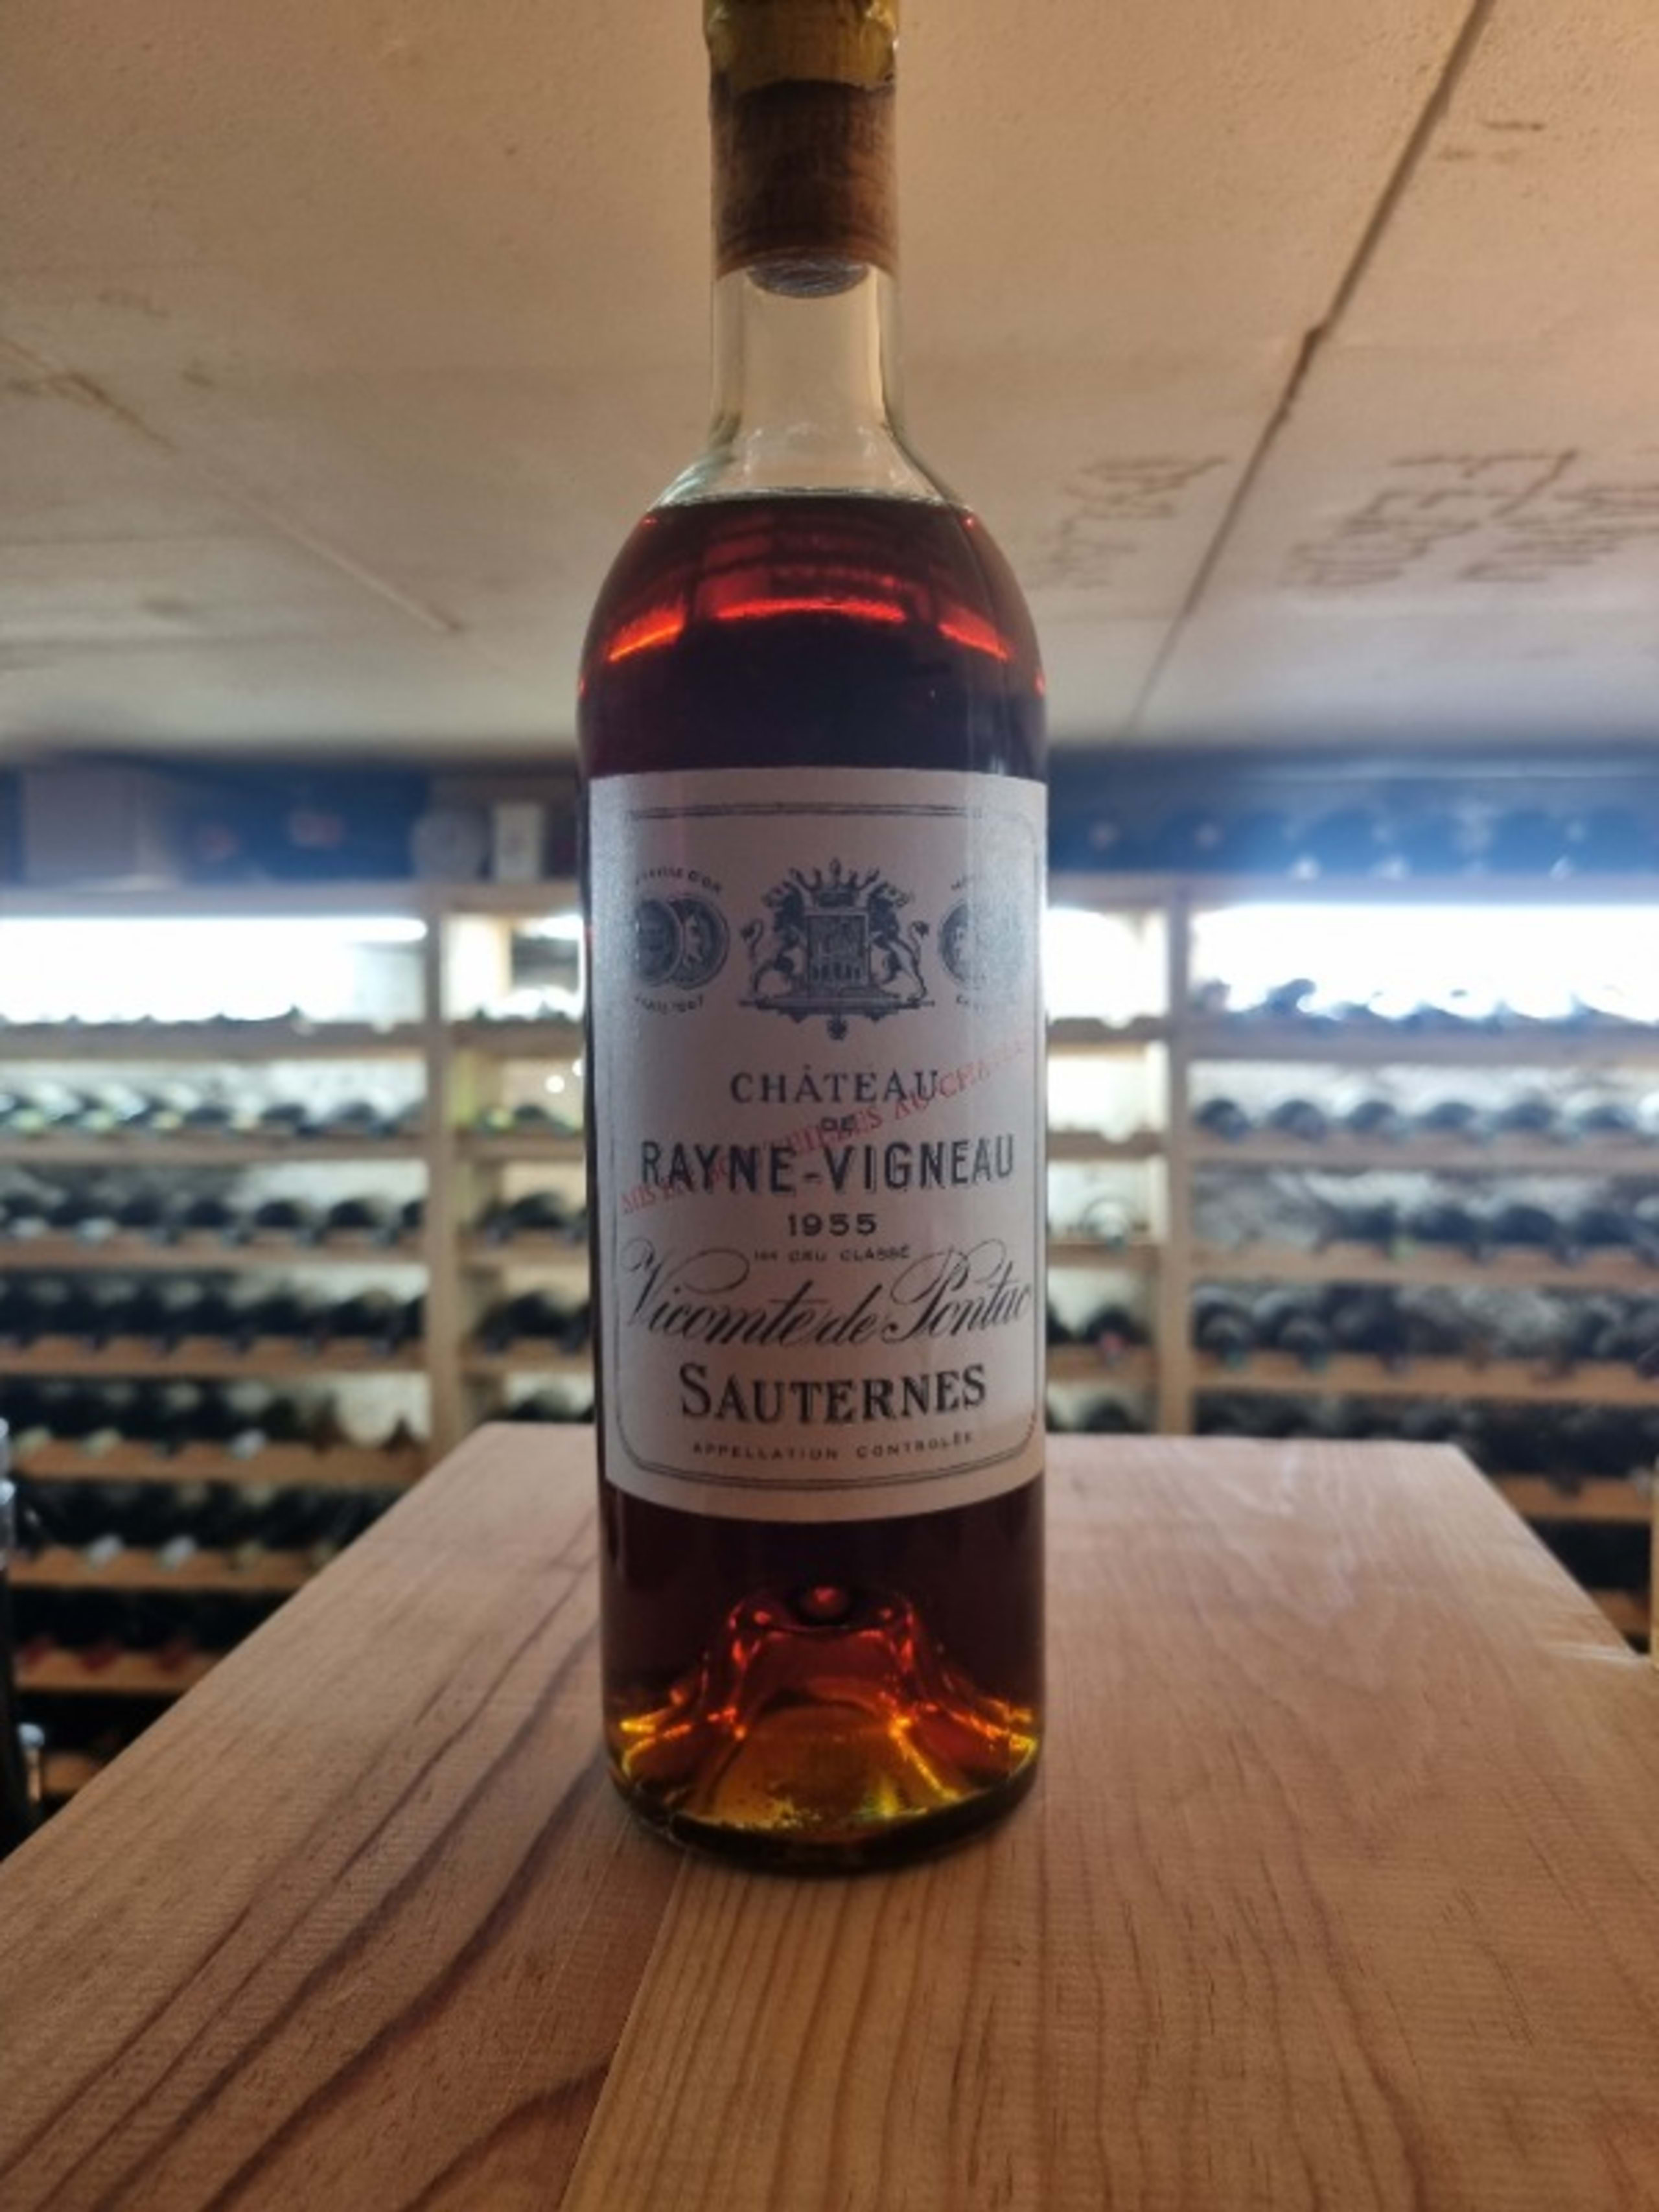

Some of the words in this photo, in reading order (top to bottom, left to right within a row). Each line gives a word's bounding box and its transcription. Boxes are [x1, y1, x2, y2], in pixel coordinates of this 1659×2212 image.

[821, 1115, 855, 1132] DE
[642, 1134, 1015, 1194] RAYNE-VIGNEAU
[788, 1214, 877, 1237] 1955
[621, 1240, 822, 1346] Vicomte
[814, 1285, 885, 1345] de
[693, 1442, 839, 1460] APPELLATION
